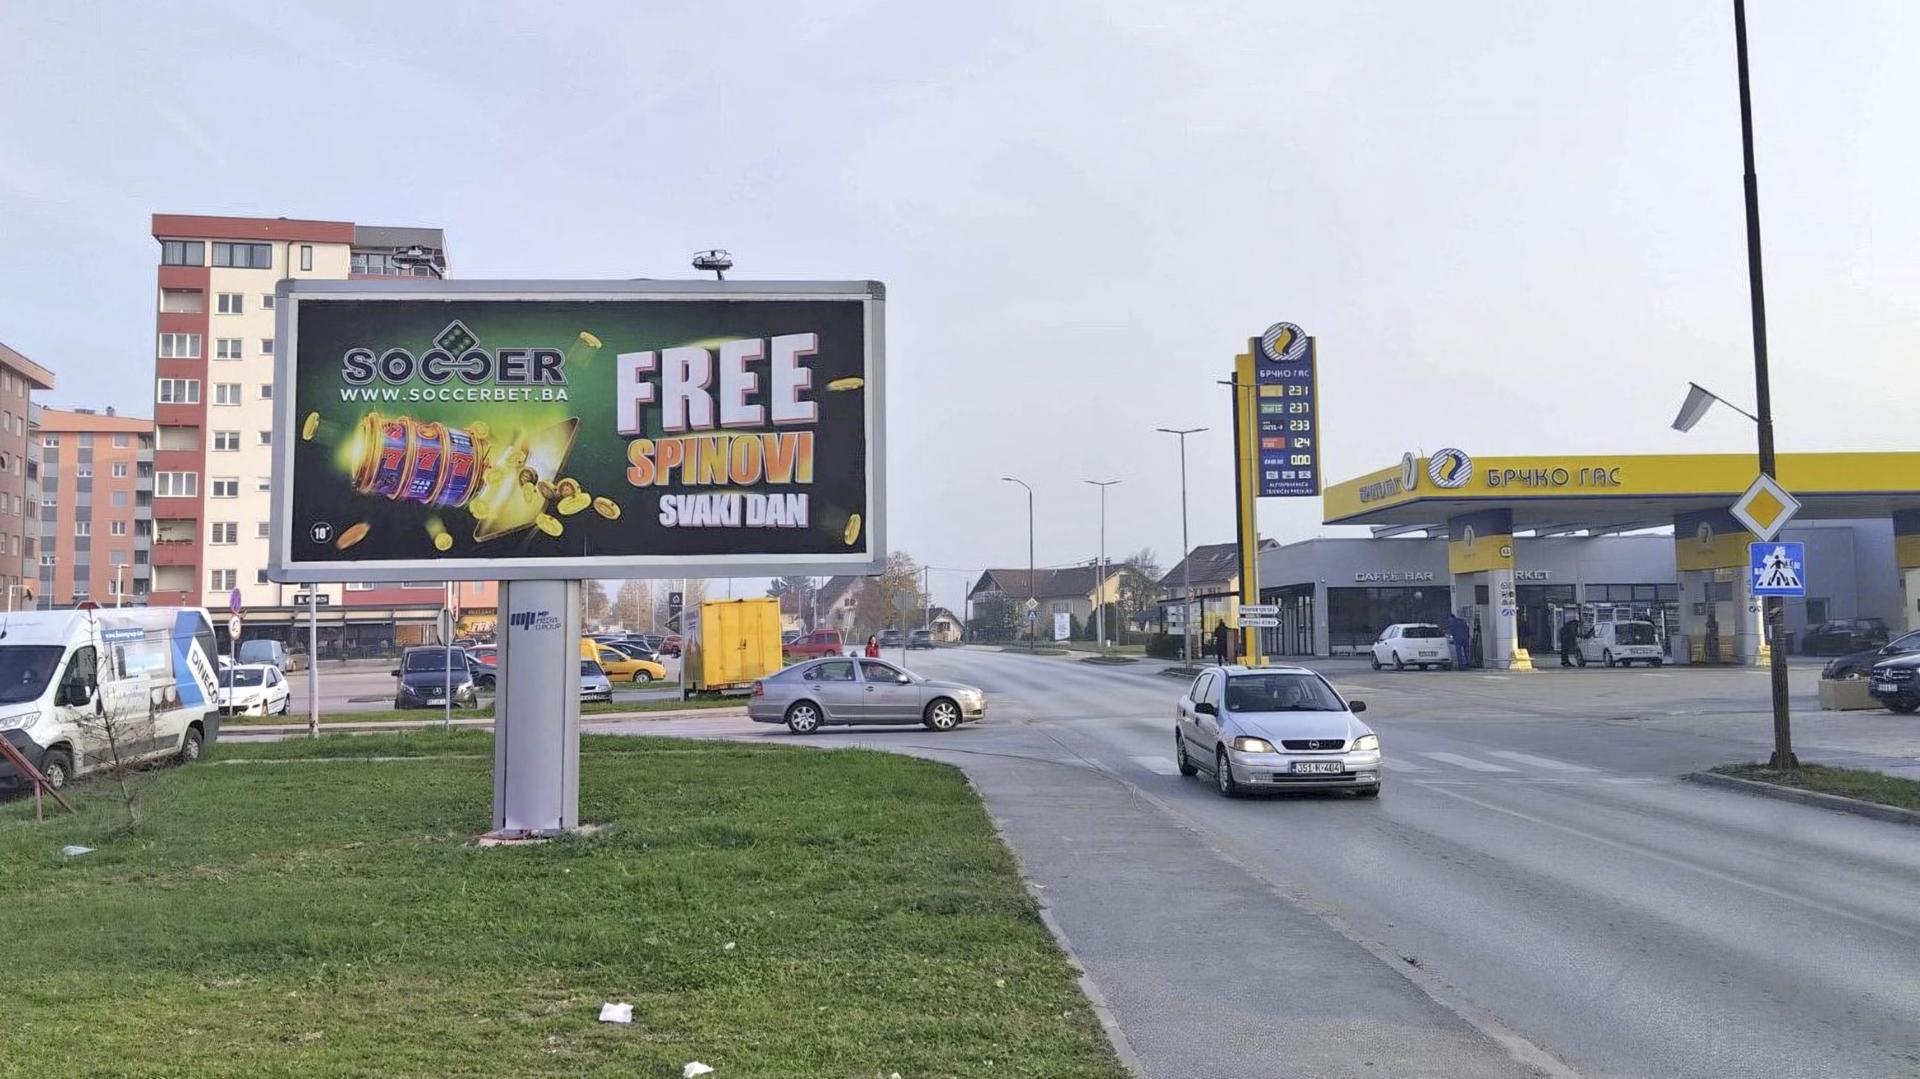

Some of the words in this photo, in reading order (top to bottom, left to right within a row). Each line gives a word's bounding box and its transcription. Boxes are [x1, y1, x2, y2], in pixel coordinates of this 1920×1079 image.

[617, 332, 819, 435] FREE
[1260, 369, 1291, 378] БРЧКО
[340, 388, 569, 401] WWW.SOCCERBET.BA
[627, 431, 814, 488] SPINOVI
[1487, 466, 1569, 487] БРЧКО
[1579, 466, 1621, 487] ГАС
[659, 492, 742, 528] SVAKI
[745, 492, 809, 529] DAN
[1515, 570, 1552, 580] RKET
